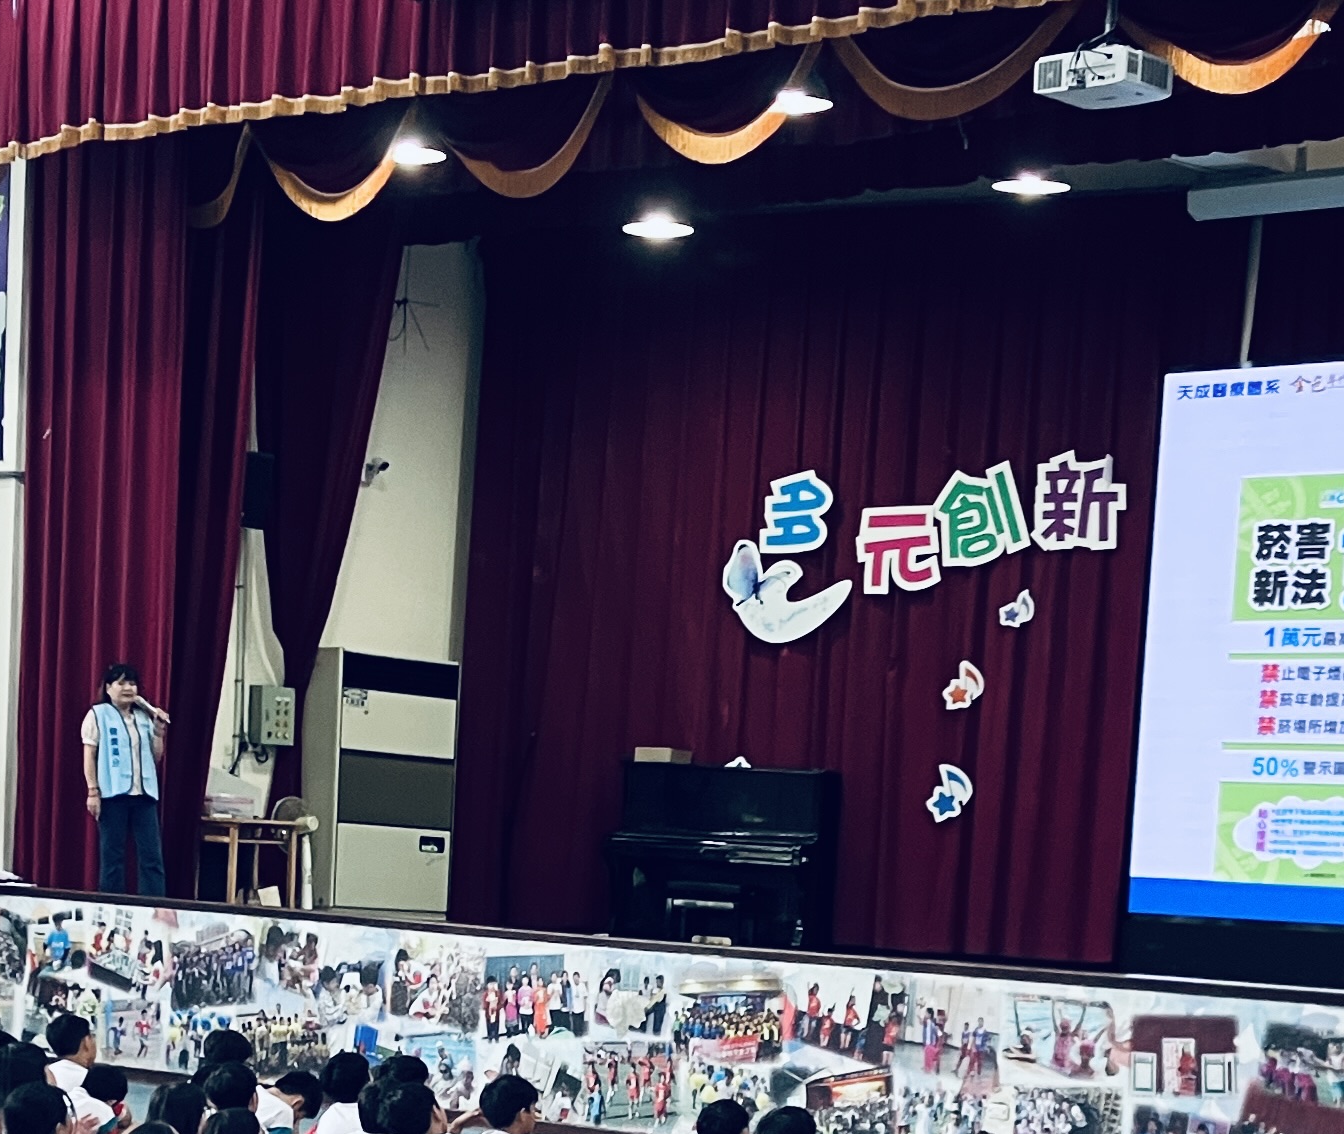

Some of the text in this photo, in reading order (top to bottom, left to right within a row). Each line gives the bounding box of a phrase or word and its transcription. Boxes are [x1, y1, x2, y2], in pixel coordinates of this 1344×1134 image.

[762, 457, 1121, 589] 多元創新
[1256, 522, 1331, 561] 菸害
[1253, 568, 1328, 606] 新法
